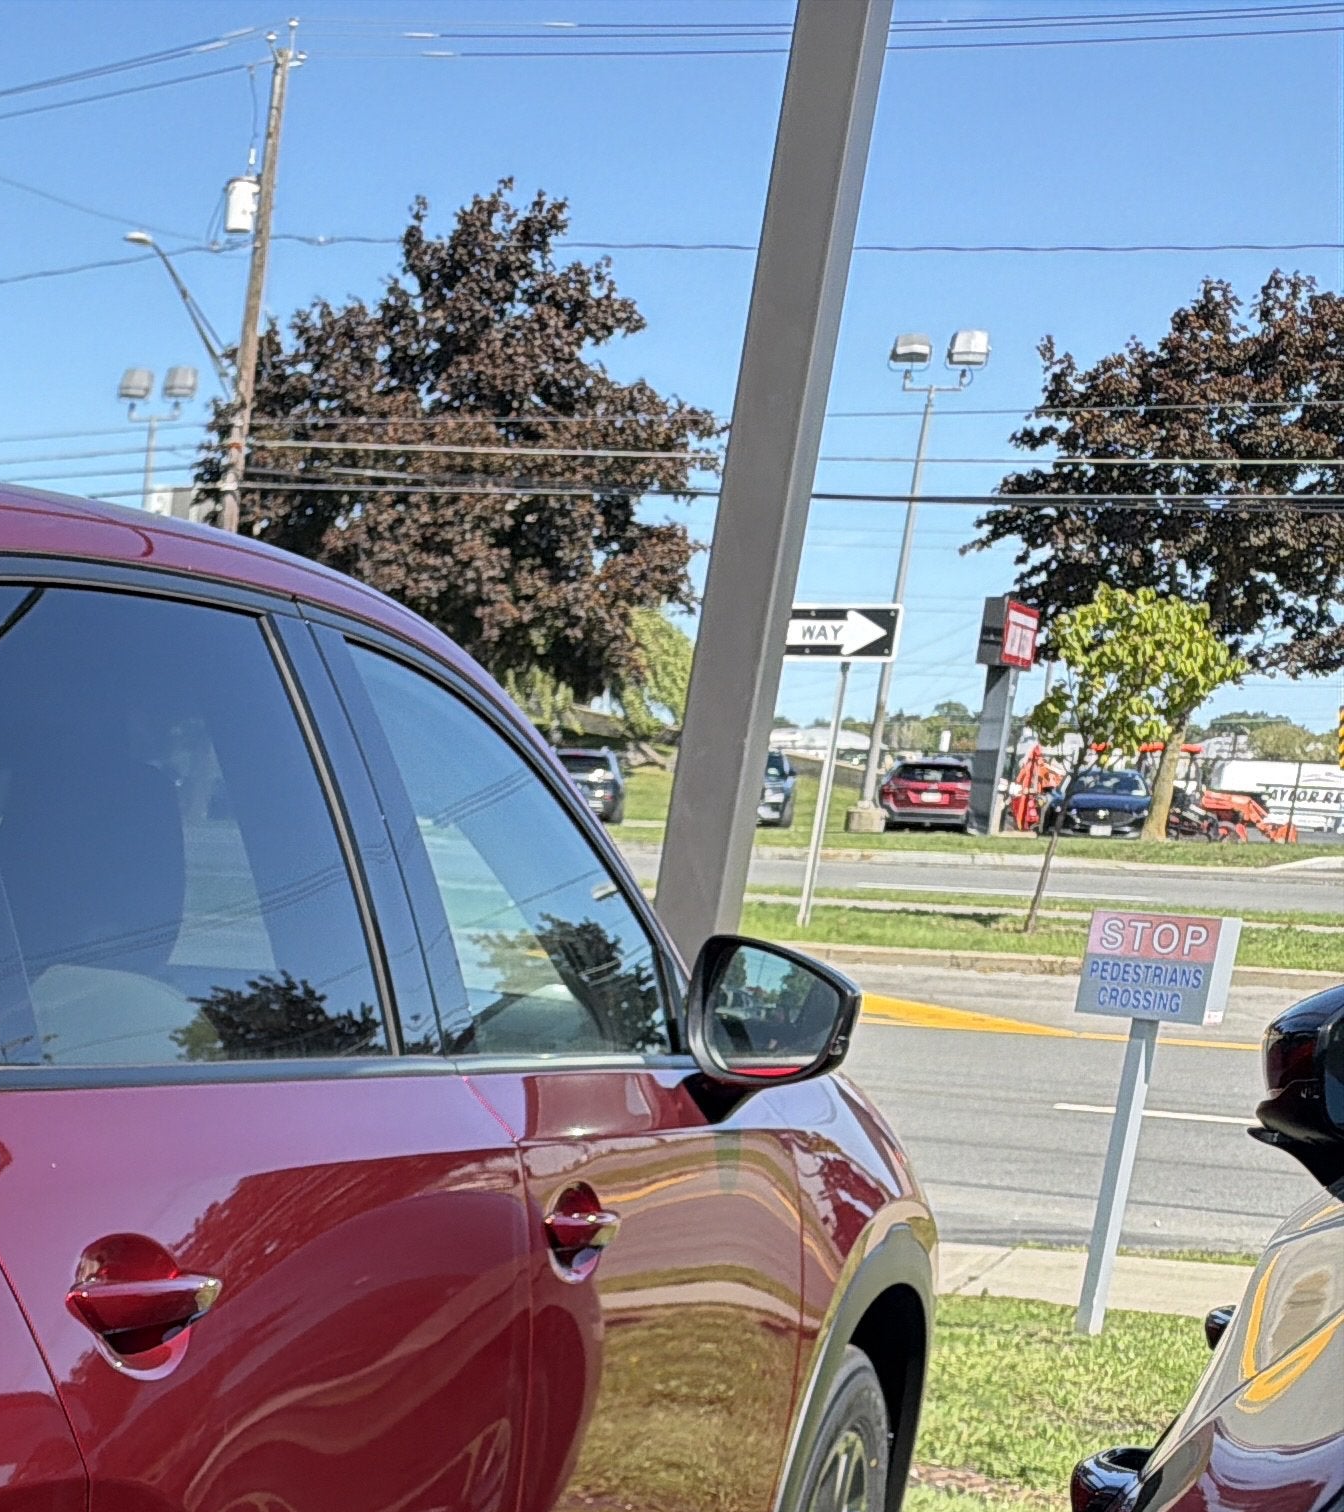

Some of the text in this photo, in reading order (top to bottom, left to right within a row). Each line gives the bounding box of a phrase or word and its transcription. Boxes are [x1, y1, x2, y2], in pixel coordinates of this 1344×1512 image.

[801, 624, 844, 641] WAY
[1264, 788, 1319, 803] AYLOR
[1100, 917, 1209, 956] STOP
[1089, 959, 1204, 990] PEDESTRIANS
[1097, 986, 1182, 1013] CROSSING
